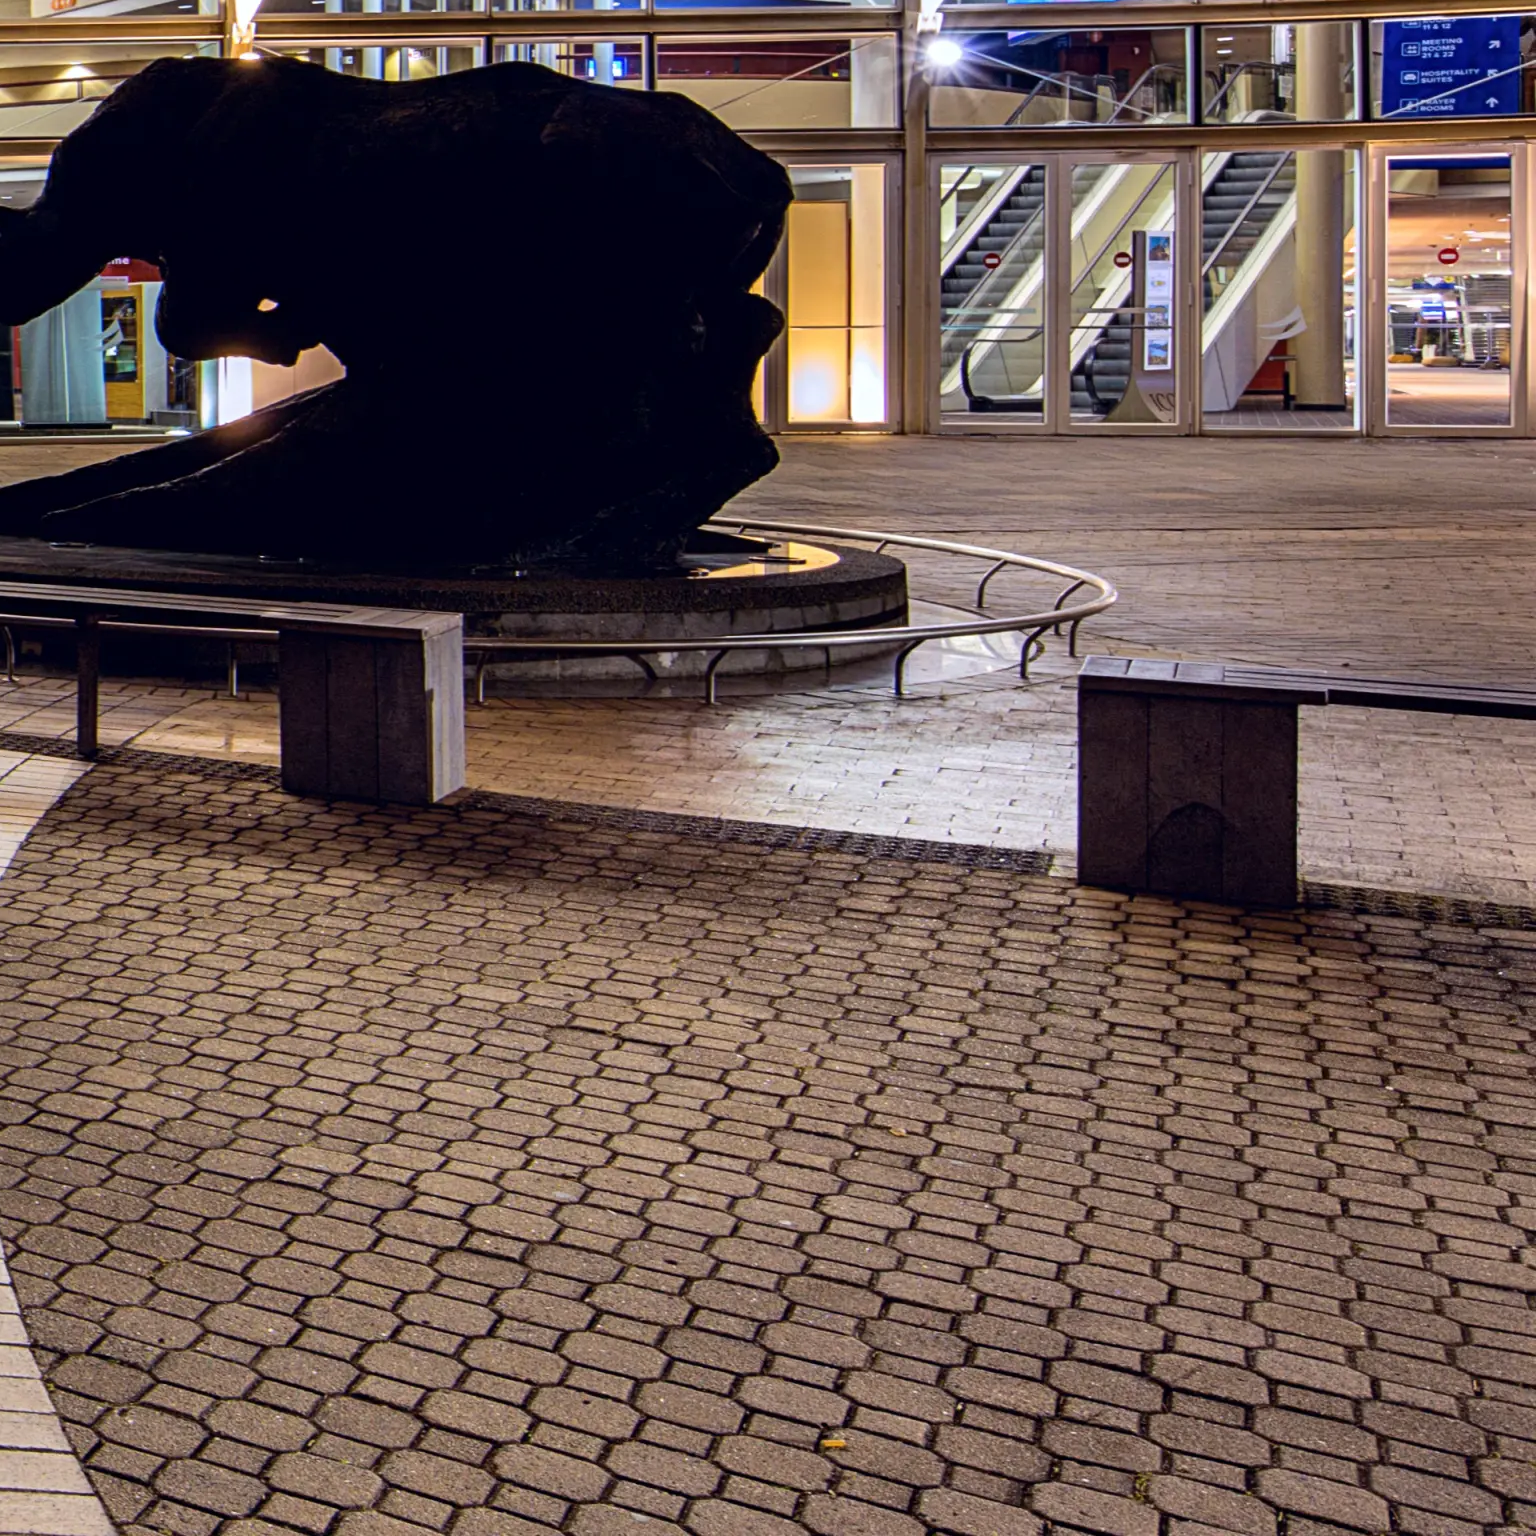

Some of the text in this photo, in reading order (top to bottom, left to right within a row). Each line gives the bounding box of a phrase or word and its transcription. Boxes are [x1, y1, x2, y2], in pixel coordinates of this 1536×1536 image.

[1422, 37, 1463, 45] MEETING
[1420, 68, 1480, 77] HOSPITALITY
[1420, 76, 1453, 84] SUITES
[1419, 104, 1454, 112] ROOMS
